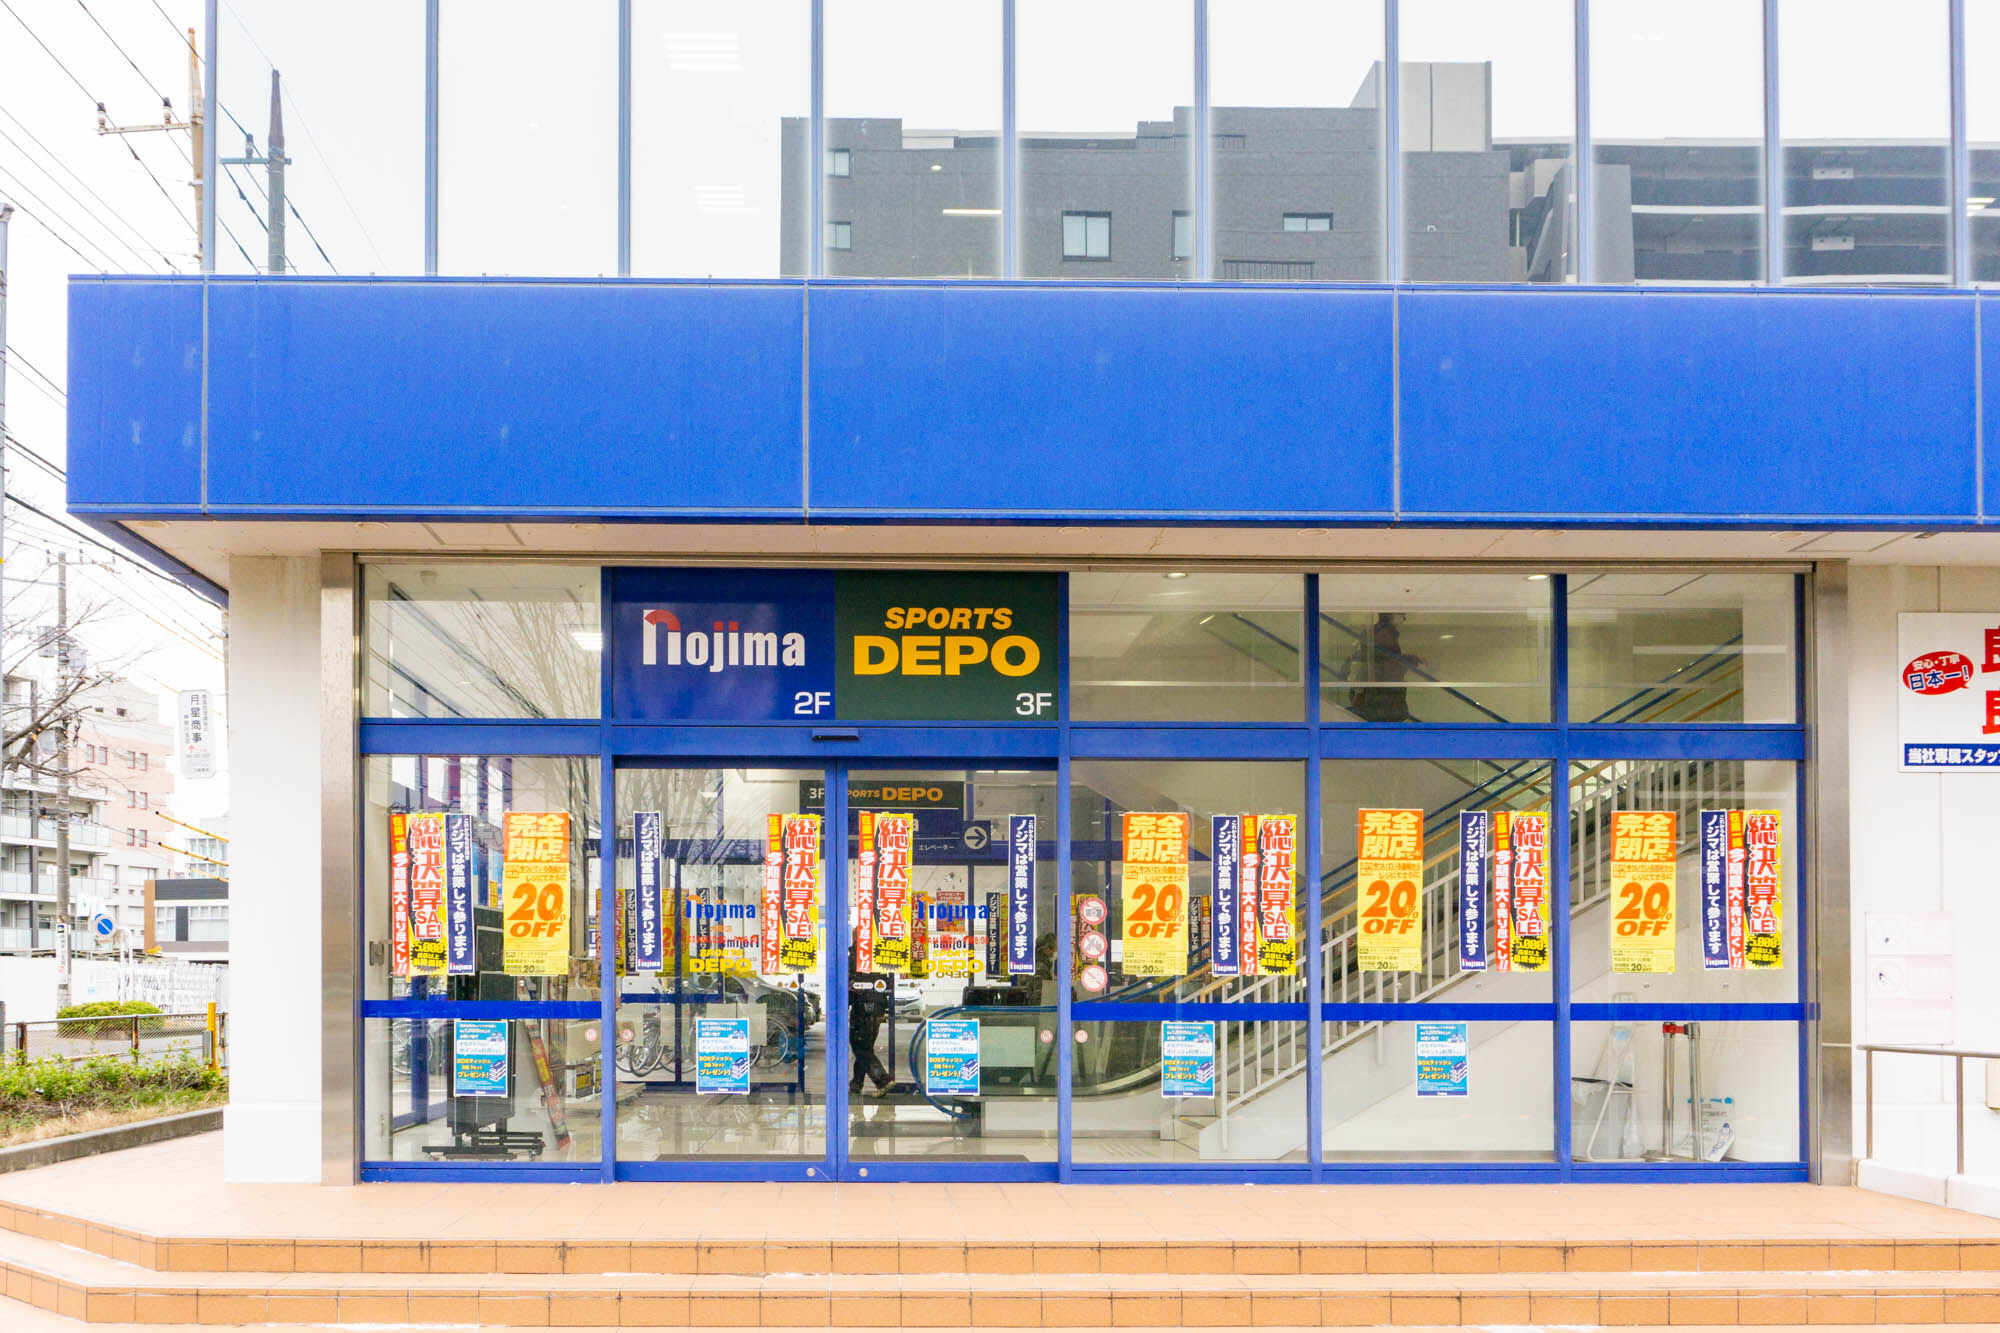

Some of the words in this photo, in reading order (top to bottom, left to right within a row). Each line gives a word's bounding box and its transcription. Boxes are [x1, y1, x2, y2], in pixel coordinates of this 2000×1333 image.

[884, 607, 1013, 630] SPORTS
[642, 608, 806, 673] nojima
[853, 635, 1041, 677] DEPO
[1908, 666, 1970, 691] 日本一!
[794, 692, 831, 714] 2F
[1015, 693, 1052, 716] 3F
[848, 790, 881, 798] PORTS
[882, 787, 944, 802] DEPO
[508, 813, 566, 837] 完全
[1127, 815, 1185, 839] 完全
[1362, 811, 1419, 835] 完全
[1615, 813, 1672, 837] 完全
[507, 837, 564, 862] 閉店
[1126, 838, 1183, 863] 閉店
[1361, 835, 1417, 859] 閉店
[1614, 836, 1670, 861] 閉店
[410, 817, 443, 911] 総決算
[783, 818, 816, 910] 総決算
[876, 817, 909, 909] 総決算
[1260, 819, 1292, 911] 総決算
[1513, 815, 1544, 908] 総決算
[1747, 814, 1777, 906] 総決算
[685, 894, 756, 921] nojima
[917, 894, 989, 922] nojima
[509, 921, 563, 938] OFF
[1128, 921, 1181, 939] OFF
[1363, 918, 1416, 935] OFF
[1616, 920, 1669, 937] OFF
[689, 958, 752, 973] DEPO
[921, 959, 985, 973] DEPO
